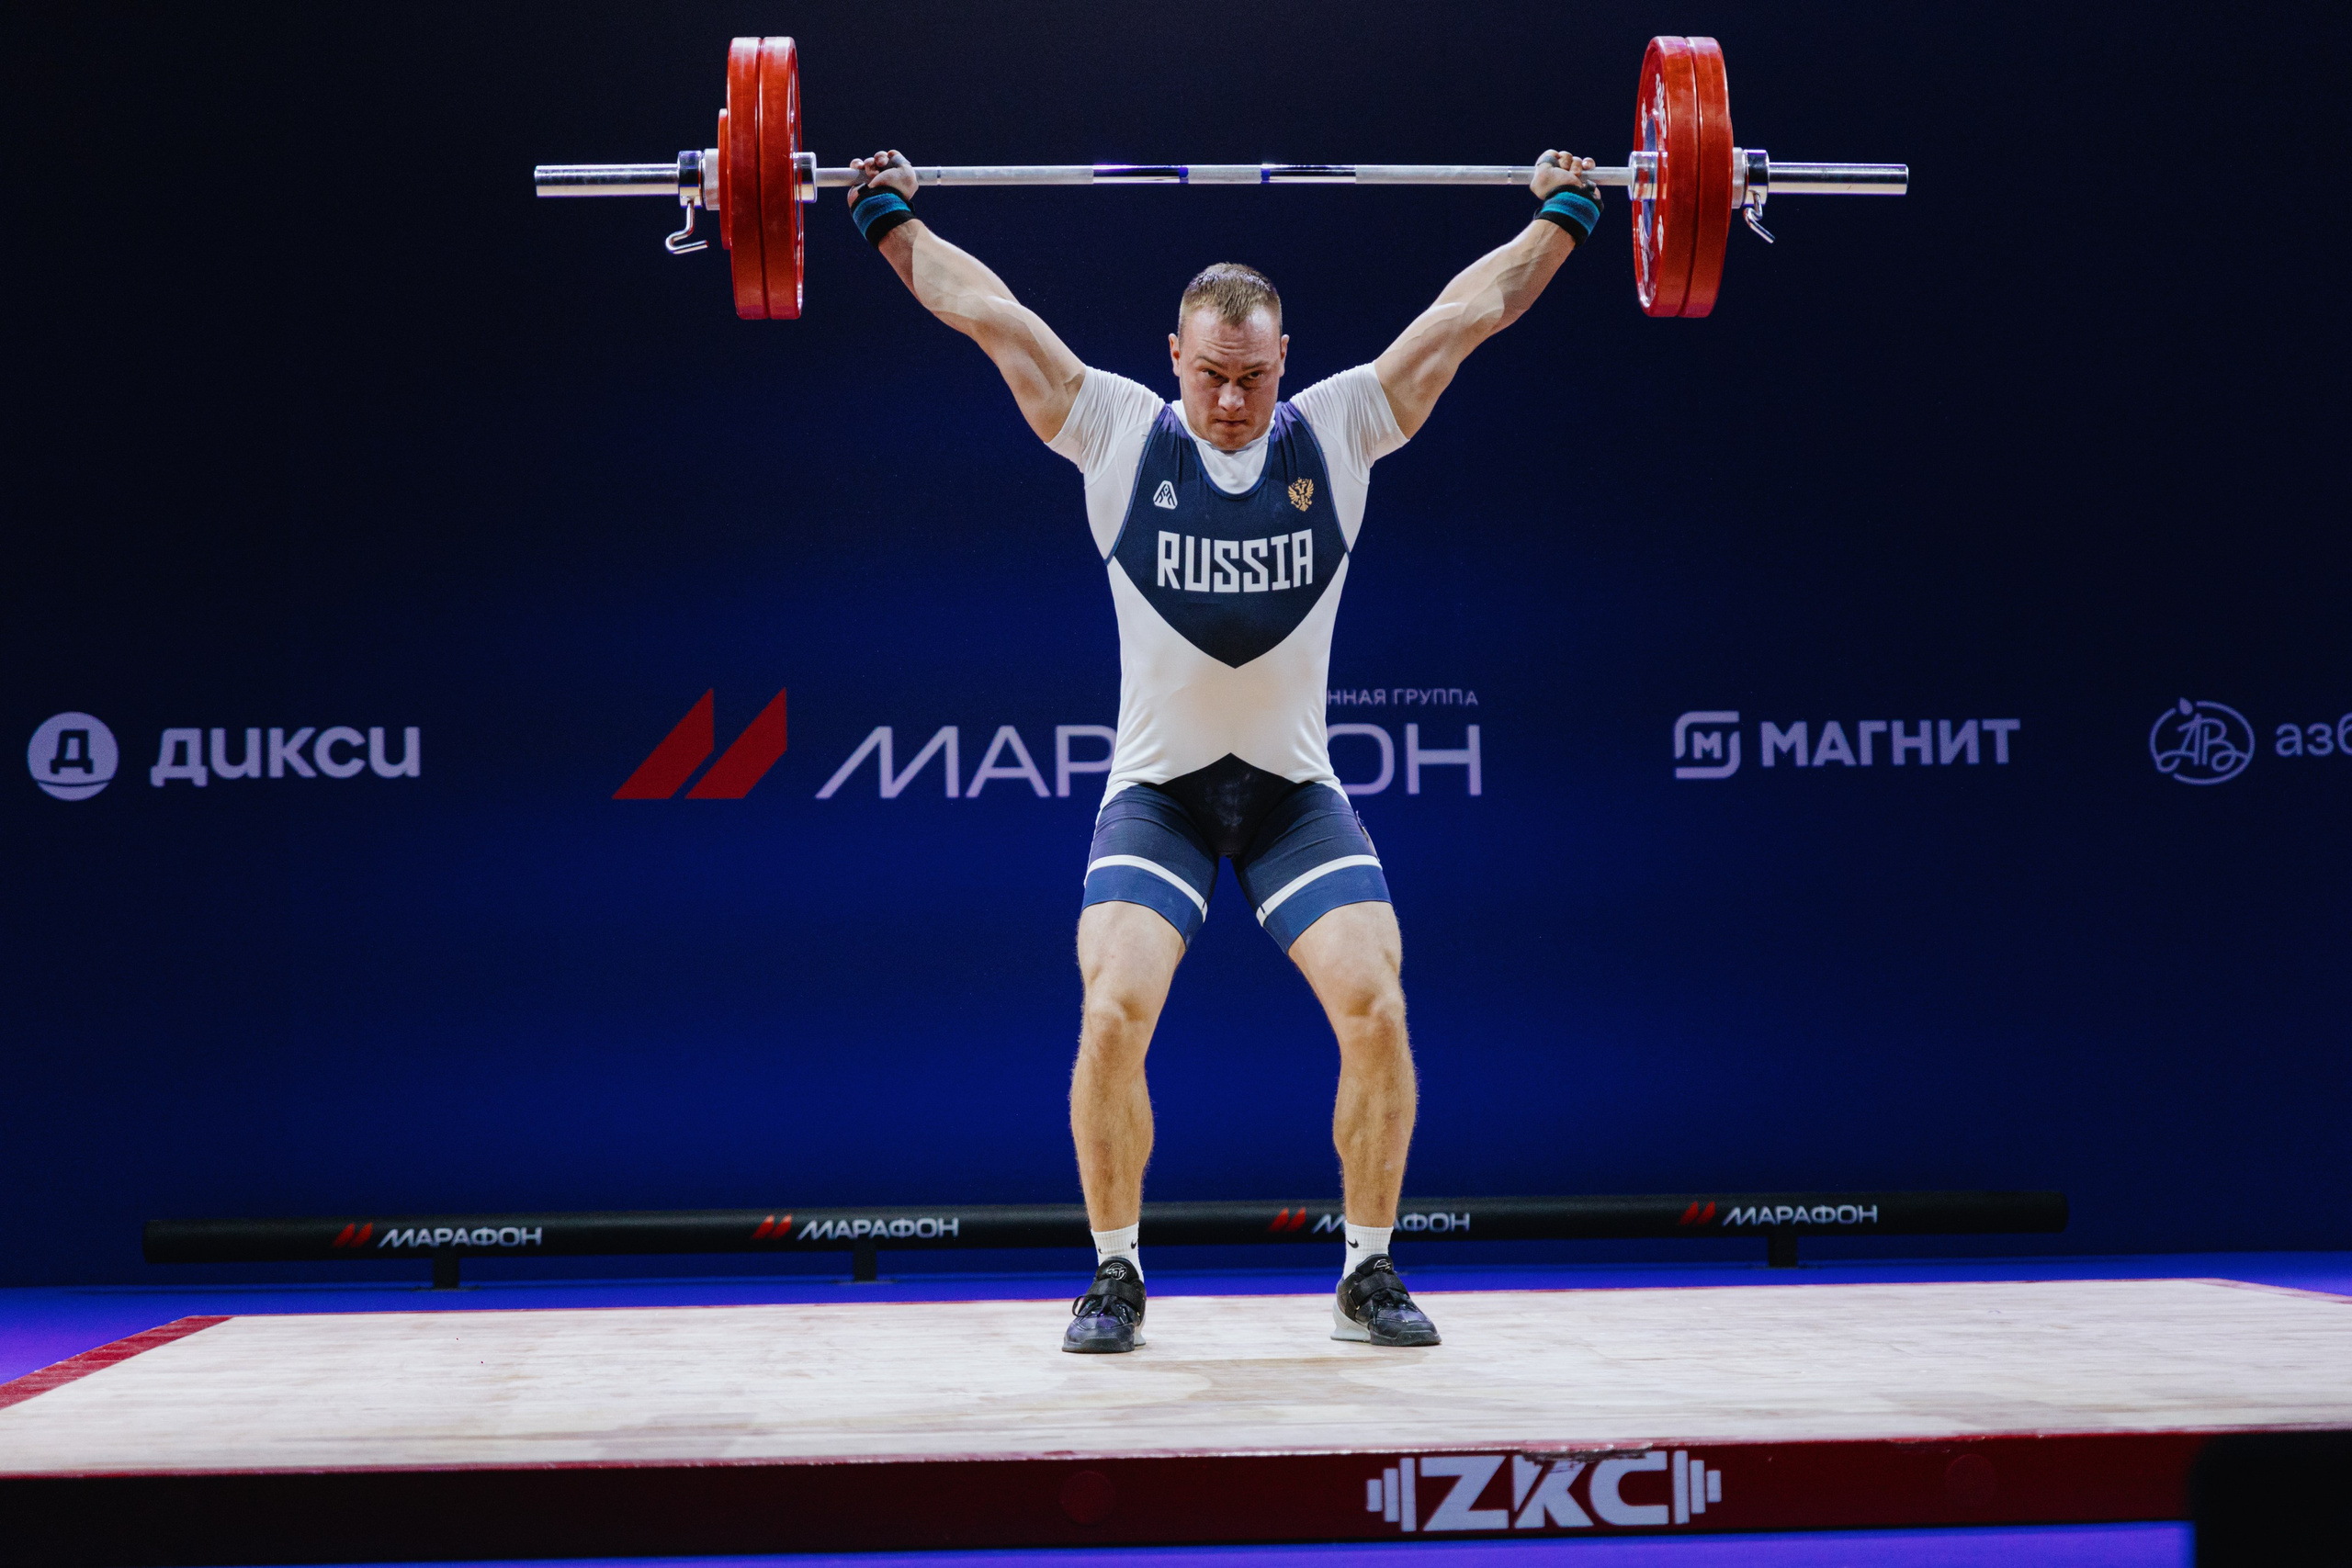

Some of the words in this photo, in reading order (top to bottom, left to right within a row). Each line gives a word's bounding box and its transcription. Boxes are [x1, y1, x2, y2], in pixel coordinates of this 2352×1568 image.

[1157, 528, 1314, 593] RUSSIA
[1327, 688, 1386, 705] ННАЯ
[1393, 688, 1479, 706] ГРУППА
[1760, 718, 2020, 767] МАГНИТ
[815, 722, 1482, 799] МАРОН
[1311, 1212, 1471, 1234] МФОН
[1722, 1204, 1879, 1226] МАРАФОН
[379, 1226, 543, 1247] МАРАФОН
[797, 1216, 959, 1239] МАРАФОН
